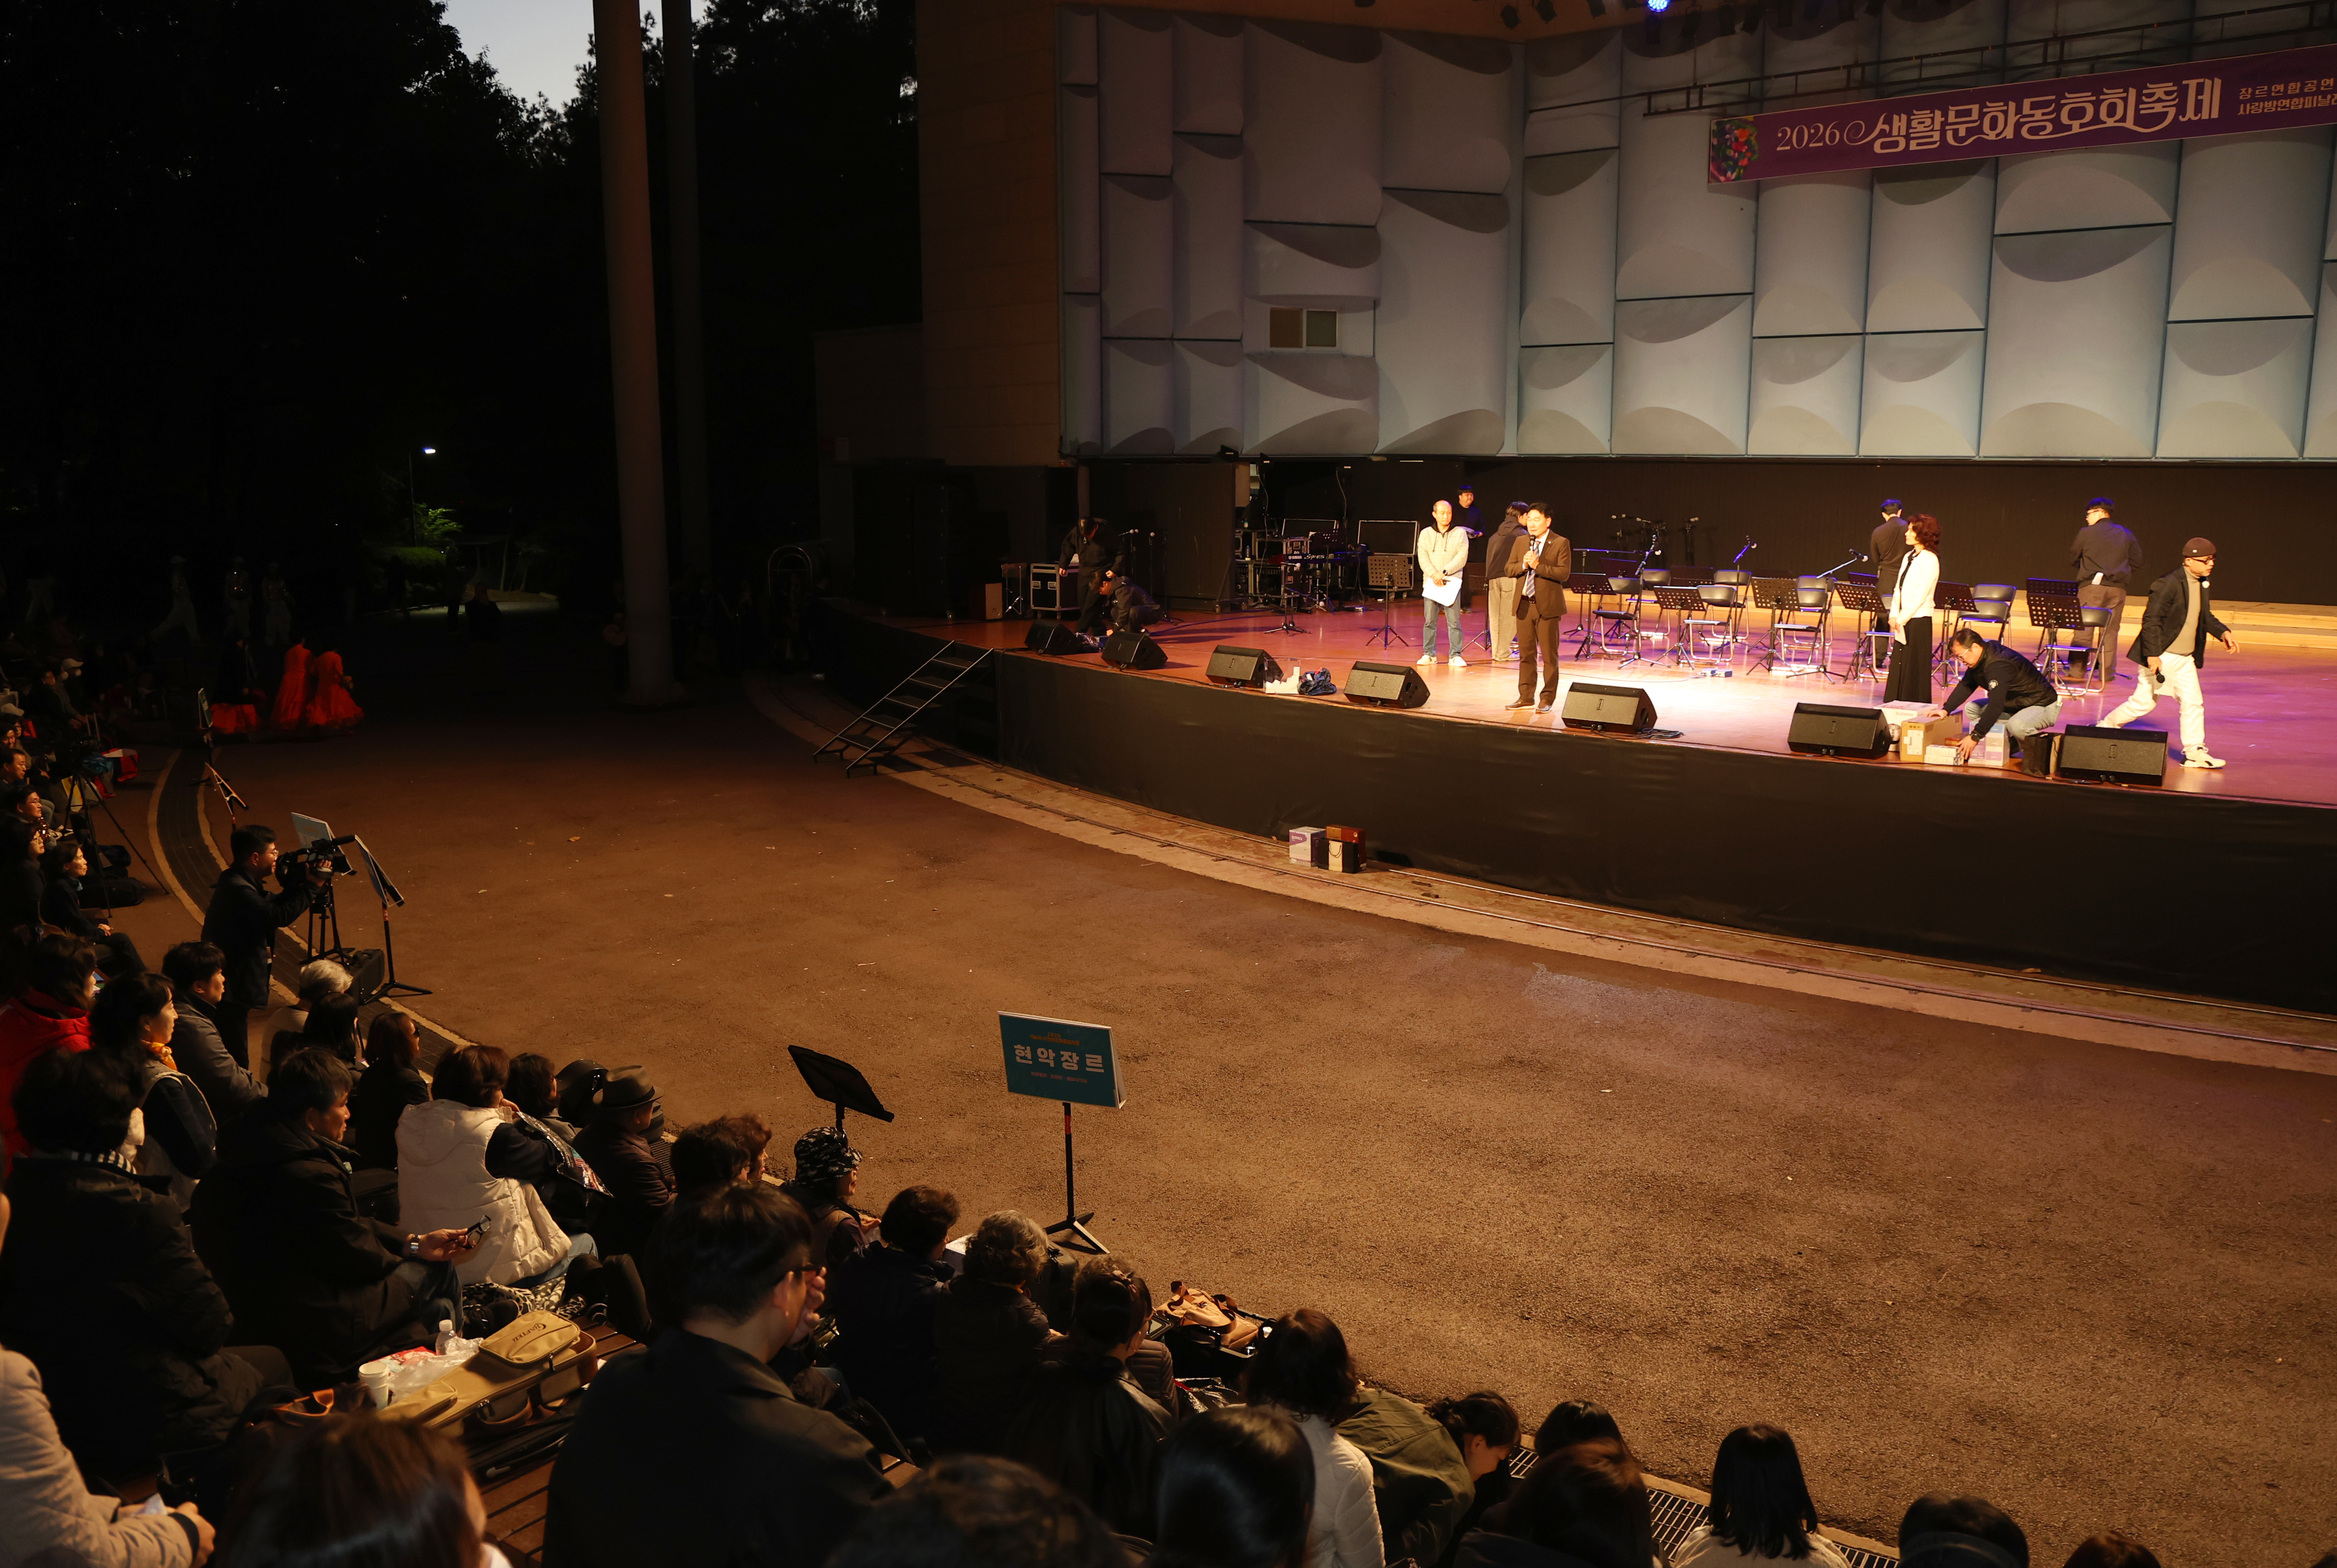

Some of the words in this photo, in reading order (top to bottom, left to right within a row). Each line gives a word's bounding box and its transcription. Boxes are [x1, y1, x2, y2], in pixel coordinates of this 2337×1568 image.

[2239, 77, 2334, 100] 장르연합공연
[1776, 121, 1840, 151] 2026
[1873, 77, 2222, 154] 생활문화동호회축제
[1014, 1044, 1104, 1073] 현악장르
[512, 1323, 546, 1342] CRAFTER
